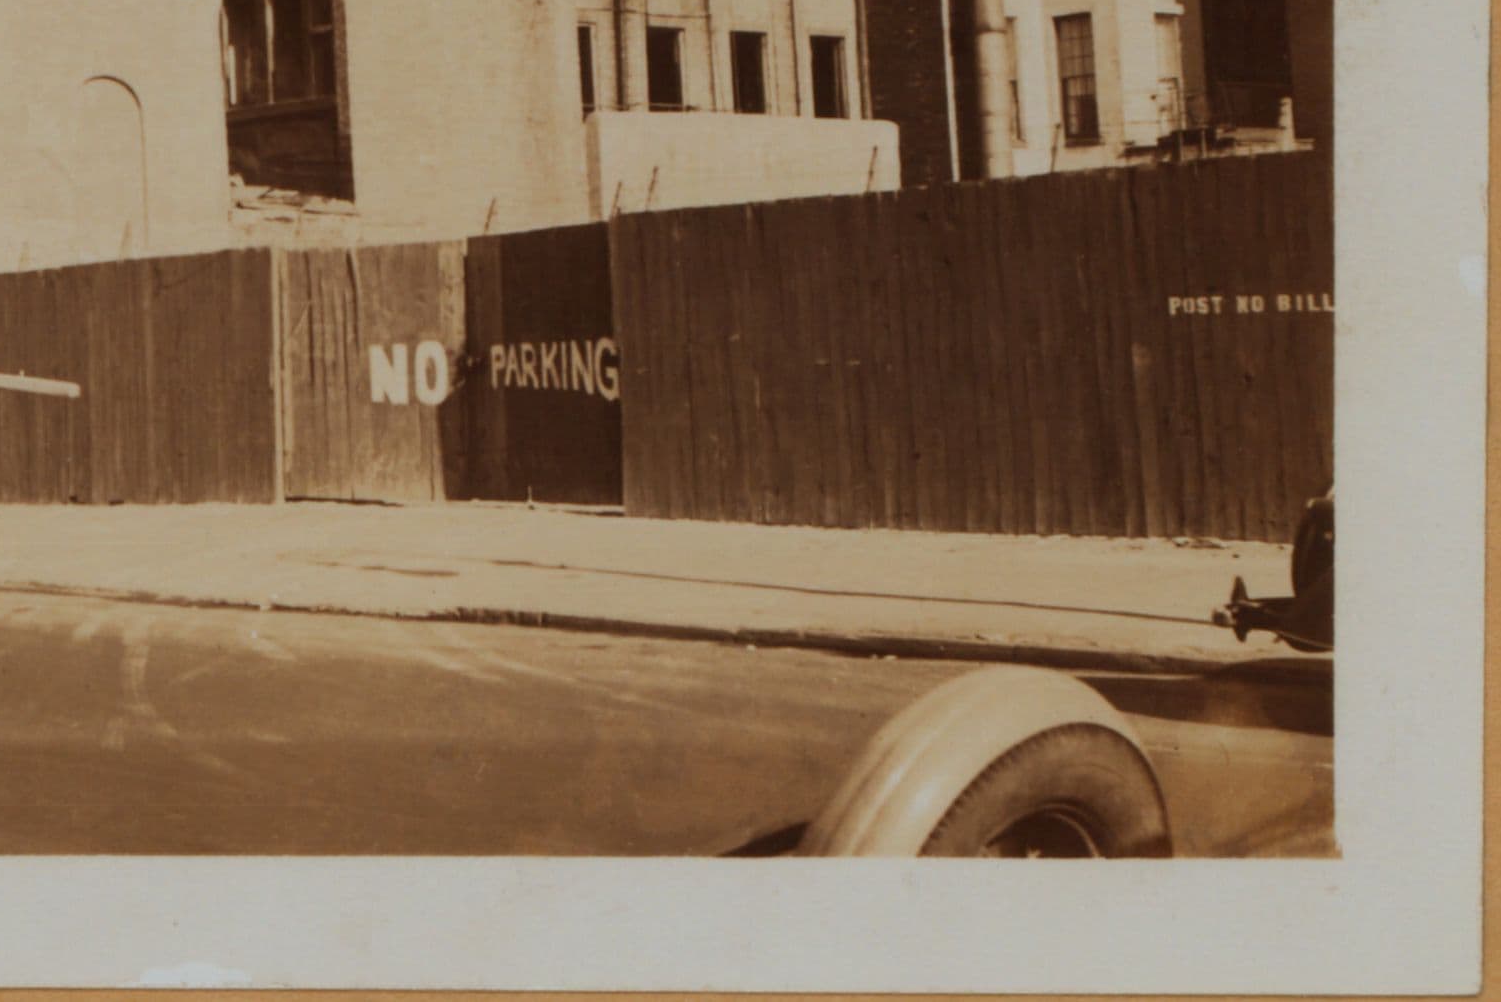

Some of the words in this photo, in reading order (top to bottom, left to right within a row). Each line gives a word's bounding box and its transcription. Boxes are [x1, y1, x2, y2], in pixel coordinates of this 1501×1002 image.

[1168, 297, 1223, 315] POST
[1236, 295, 1265, 313] NO
[368, 340, 449, 406] NO
[489, 337, 621, 400] PARKING
